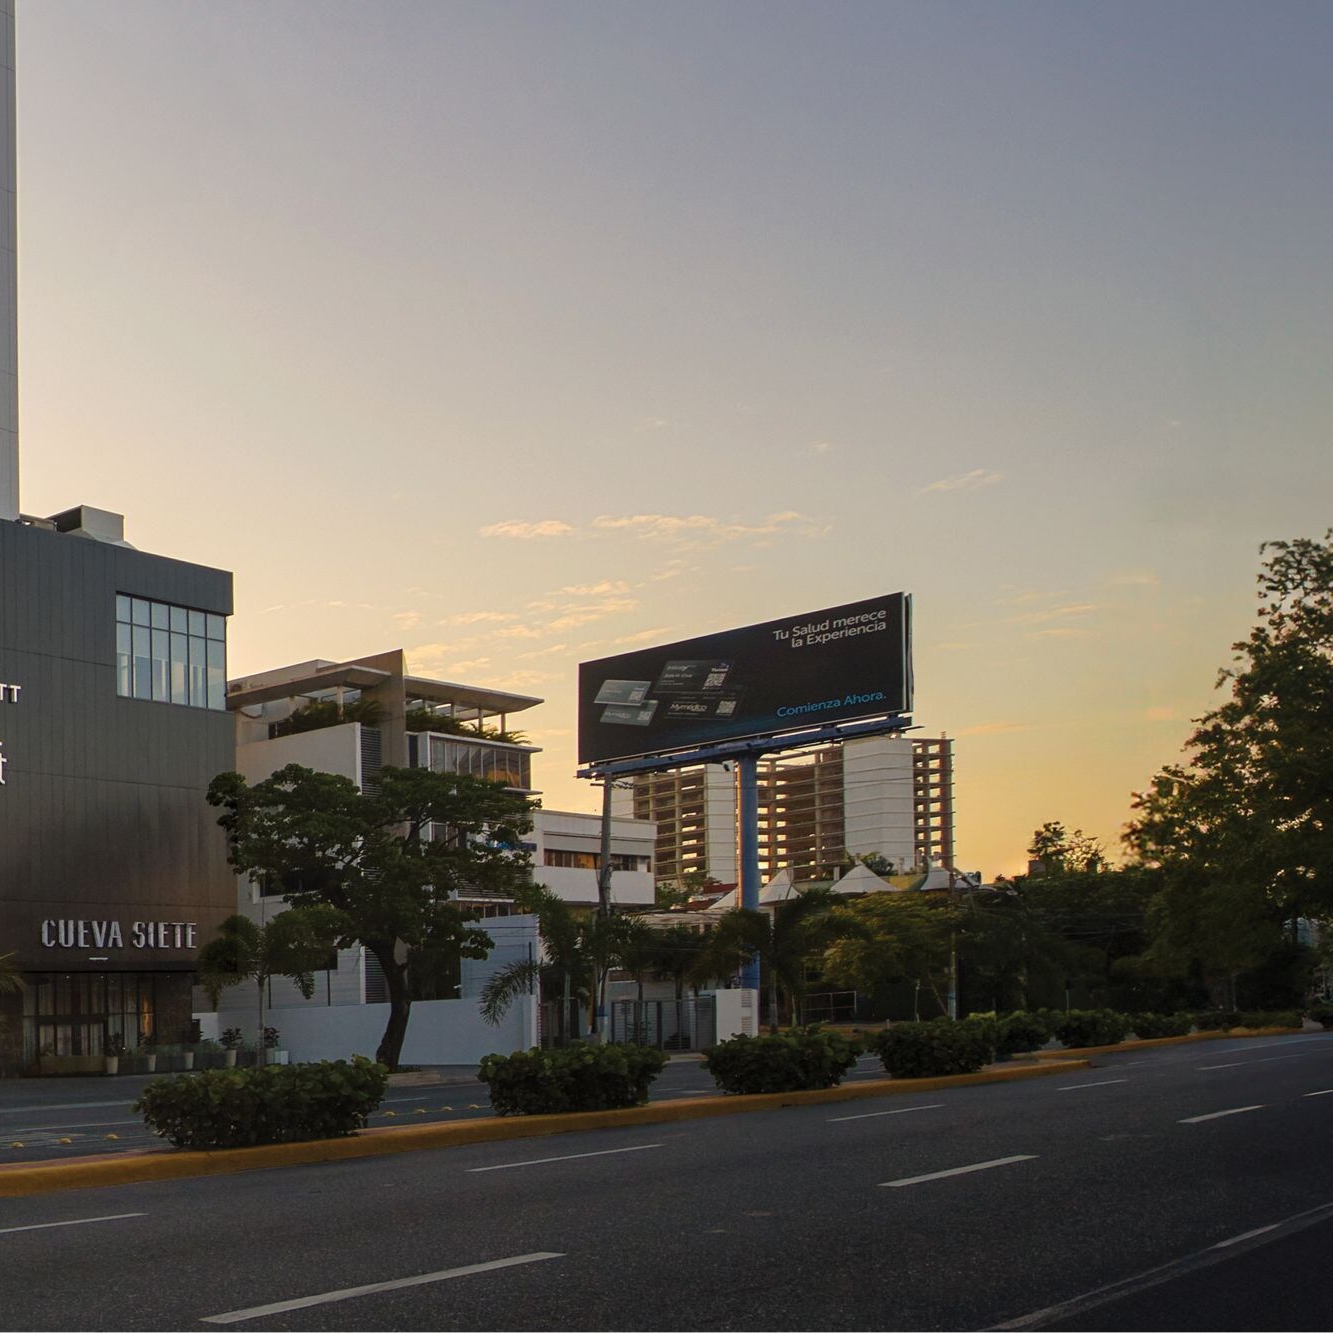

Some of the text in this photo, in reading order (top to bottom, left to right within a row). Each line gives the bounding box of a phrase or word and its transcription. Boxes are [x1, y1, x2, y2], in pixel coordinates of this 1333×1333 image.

[773, 609, 886, 640] Tu Salud merece
[791, 620, 886, 648] la Experiencia
[777, 691, 887, 717] Comienza Ahora.
[41, 919, 197, 948] CUEVA SIETE
